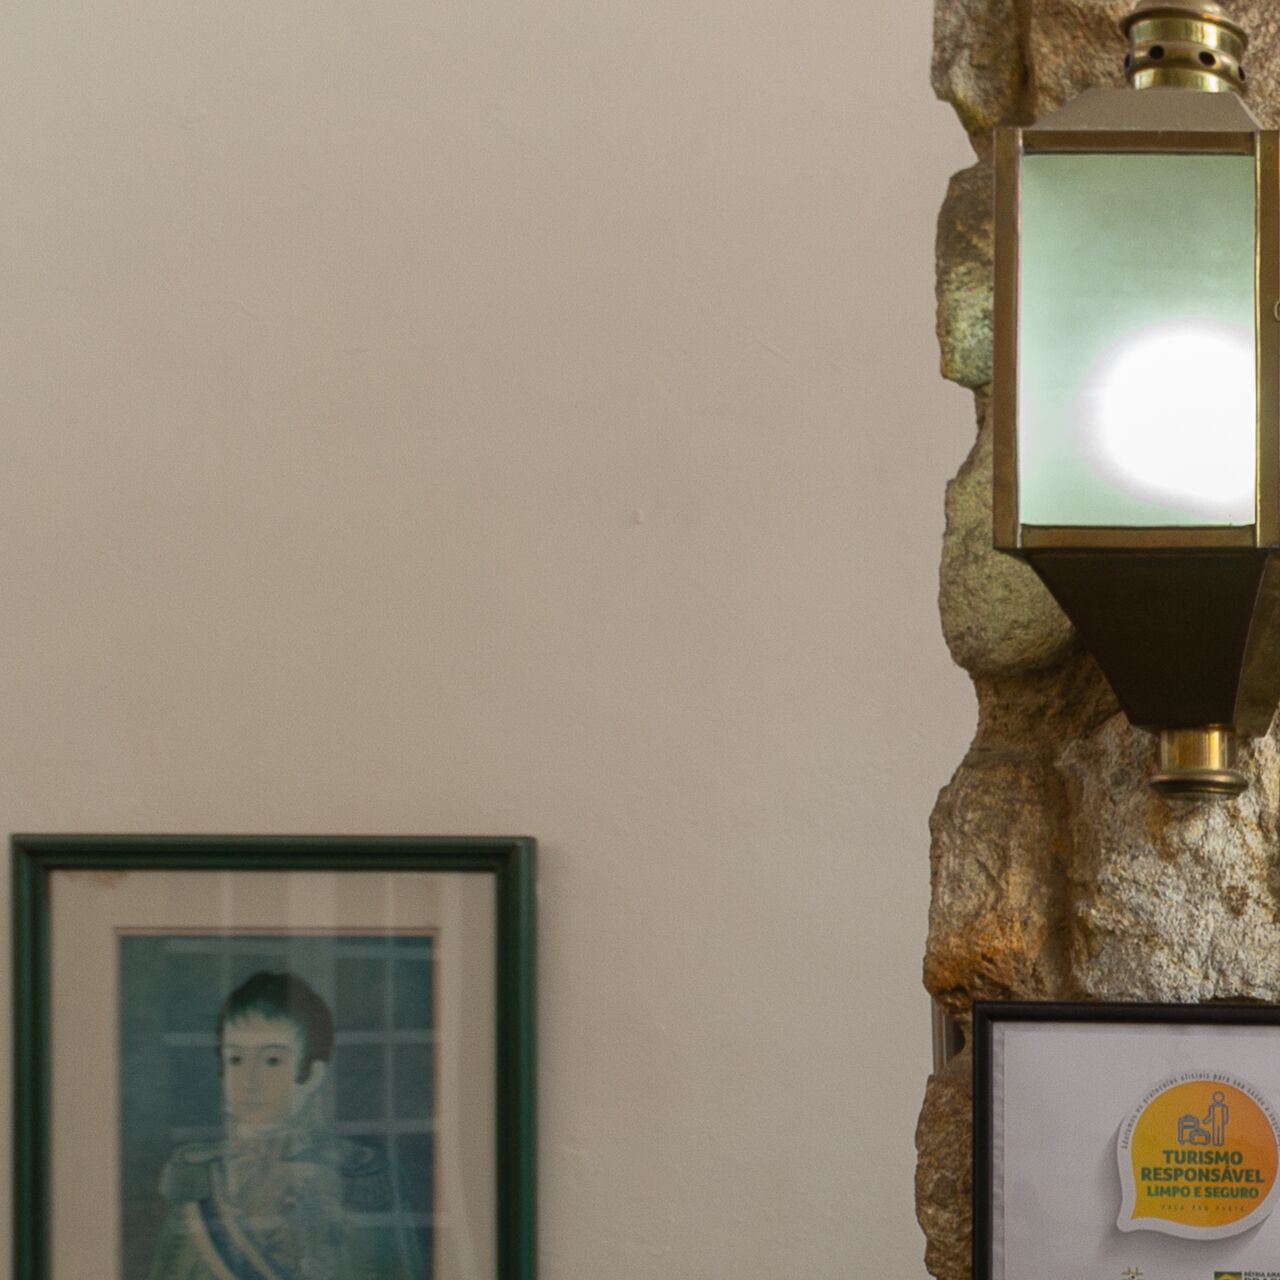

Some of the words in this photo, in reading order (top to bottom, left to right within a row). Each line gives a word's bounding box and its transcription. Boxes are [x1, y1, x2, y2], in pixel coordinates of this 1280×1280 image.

[1162, 1150, 1243, 1165] TURISMO
[1141, 1165, 1264, 1183] RESPONSÁVEL
[1147, 1186, 1190, 1198] LIMPO
[1194, 1186, 1201, 1198] E
[1204, 1186, 1259, 1199] SEGURO
